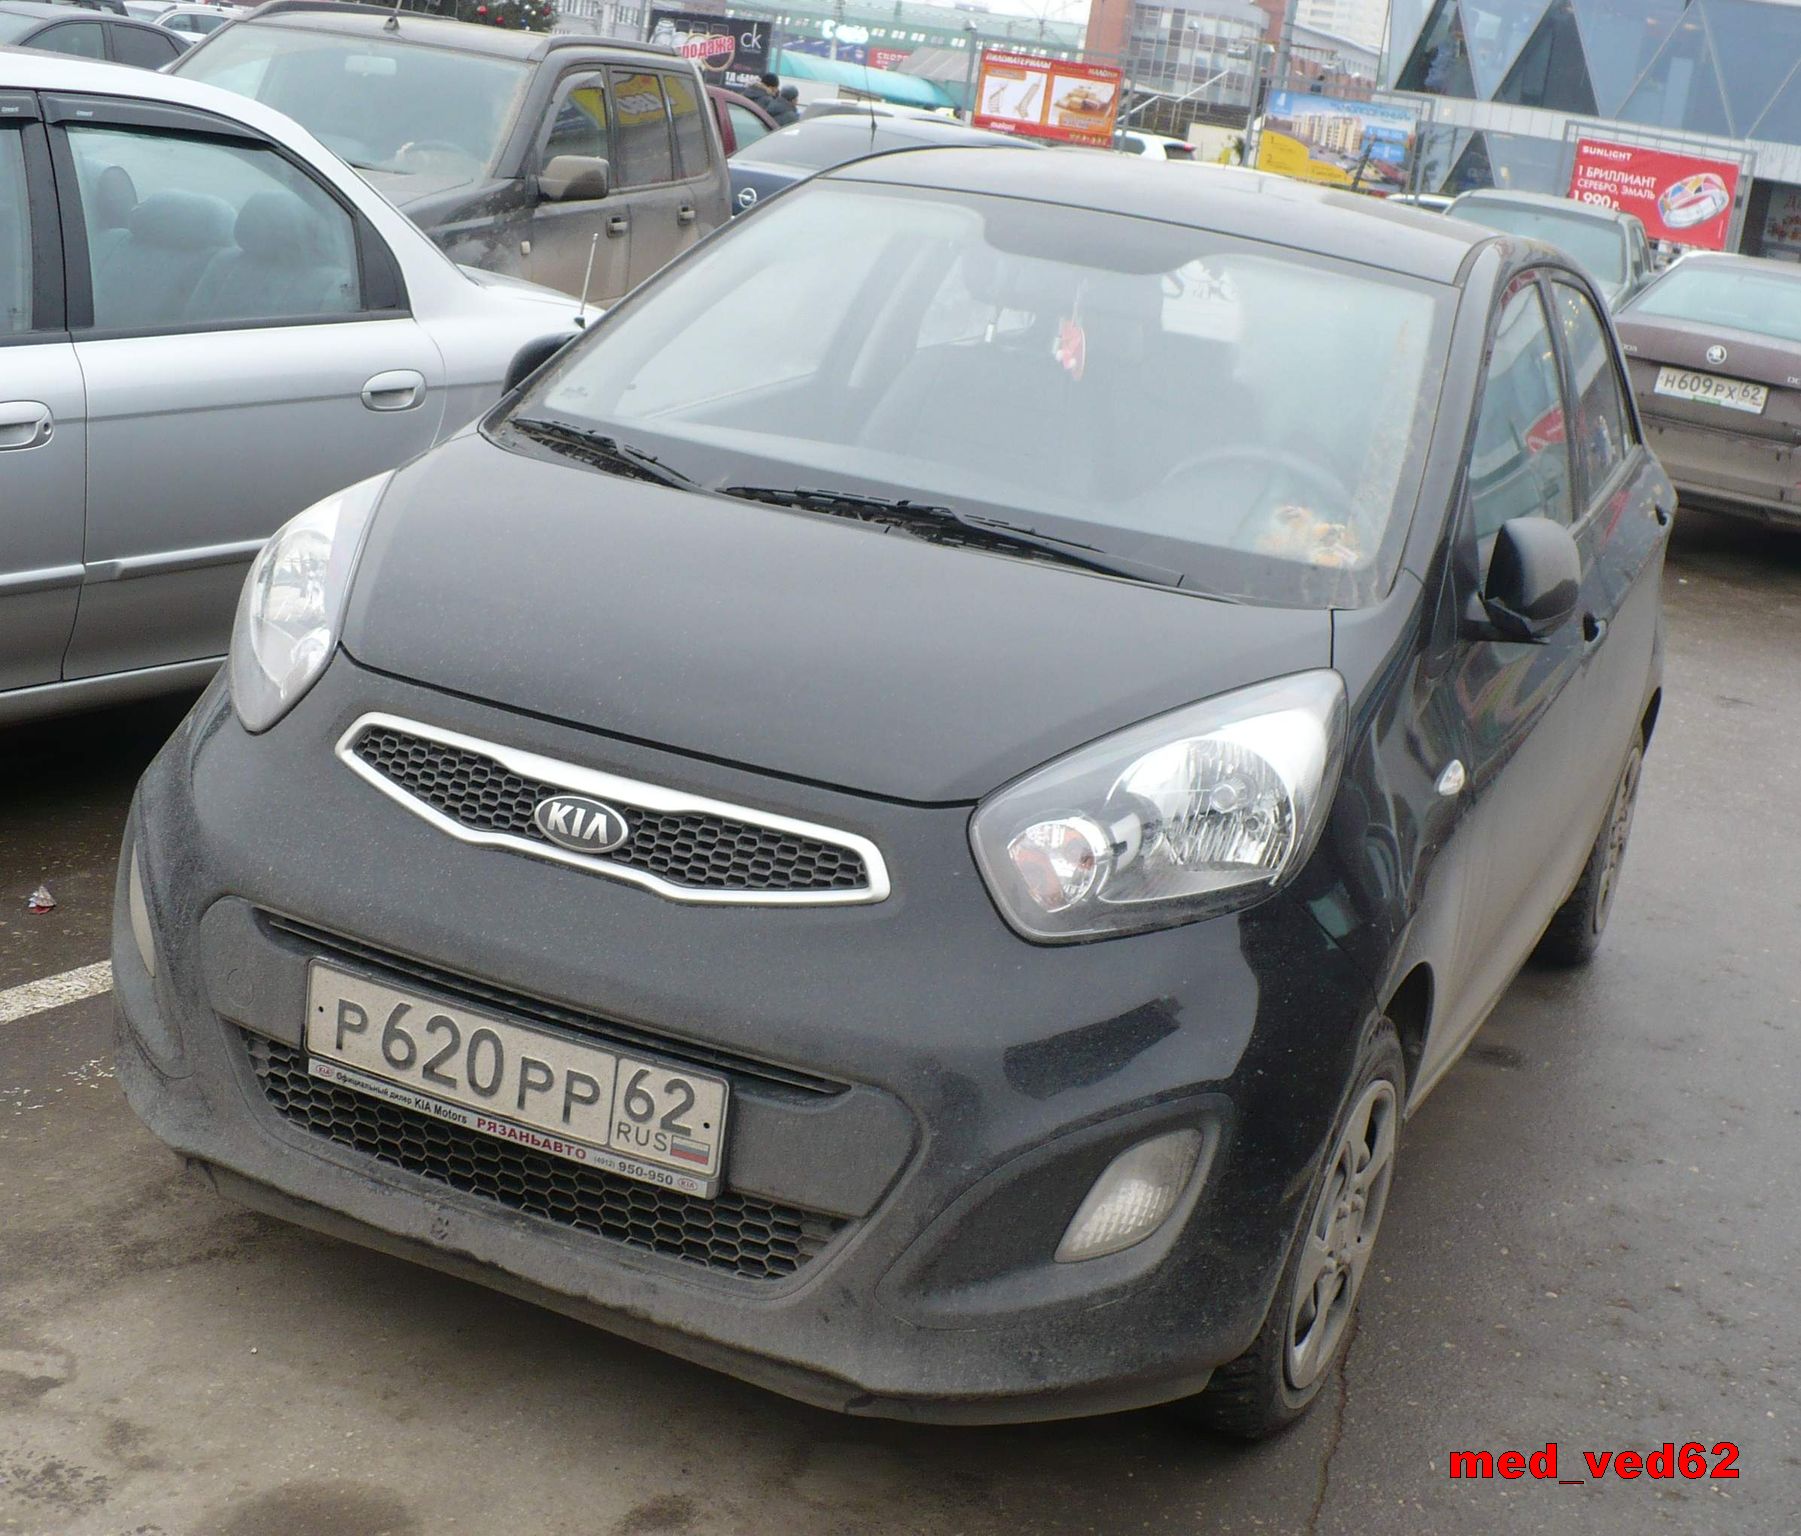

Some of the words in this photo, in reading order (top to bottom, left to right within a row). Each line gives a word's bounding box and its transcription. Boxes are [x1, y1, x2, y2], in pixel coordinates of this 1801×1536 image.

[741, 23, 762, 49] ck
[1582, 145, 1632, 161] SUNLIGHT
[1578, 165, 1584, 177] 1
[1586, 166, 1657, 188] БРИЛЛИАНТ
[1577, 178, 1618, 195] СЕРЕБРО,
[1621, 187, 1656, 200] ЭМАЛЬ
[1582, 191, 1611, 207] 990
[1741, 384, 1762, 400] 62
[547, 801, 608, 844] KIA
[623, 1068, 696, 1136] 62
[336, 1072, 389, 1096] Официальный
[389, 1090, 412, 1105] дилер
[414, 1098, 431, 1113] KIA
[434, 1104, 468, 1124] Motors
[476, 1117, 587, 1161] РЯЗАНЬАВТО
[593, 1155, 616, 1170] (4912)
[618, 1160, 673, 1186] 950-950
[616, 1121, 668, 1152] RUS
